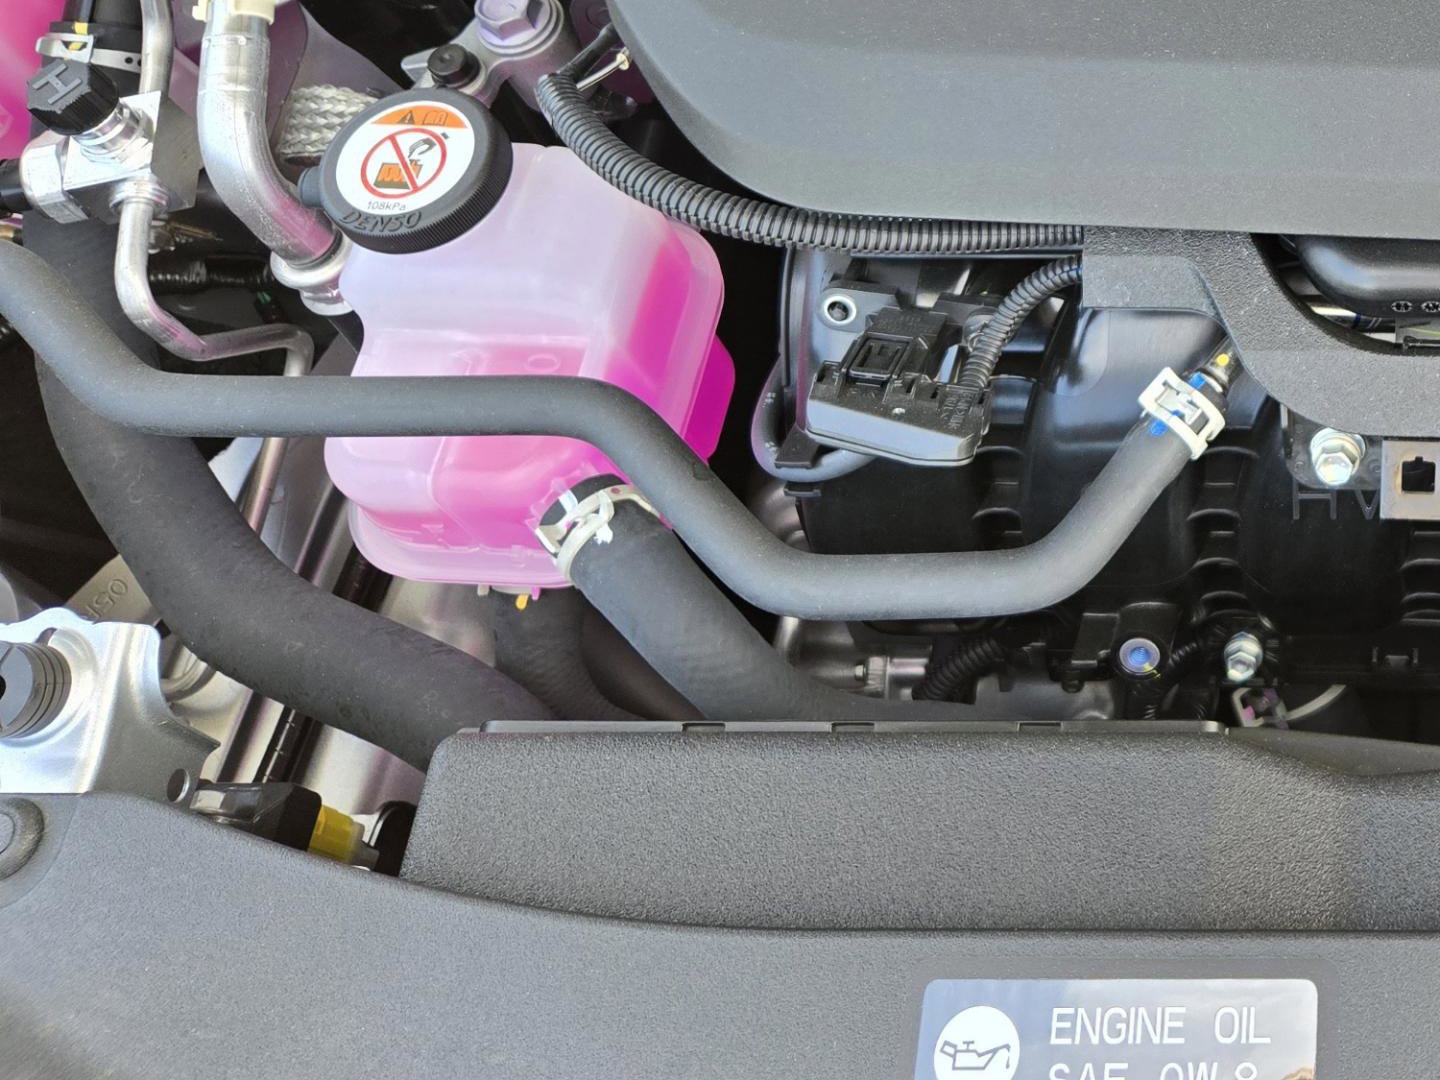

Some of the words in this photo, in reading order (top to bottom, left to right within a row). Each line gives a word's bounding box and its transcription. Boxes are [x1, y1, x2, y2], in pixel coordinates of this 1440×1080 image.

[366, 200, 407, 210] 108kPa
[340, 209, 422, 233] DENSO
[1049, 1006, 1187, 1045] ENGINE
[1214, 1006, 1272, 1045] OIL
